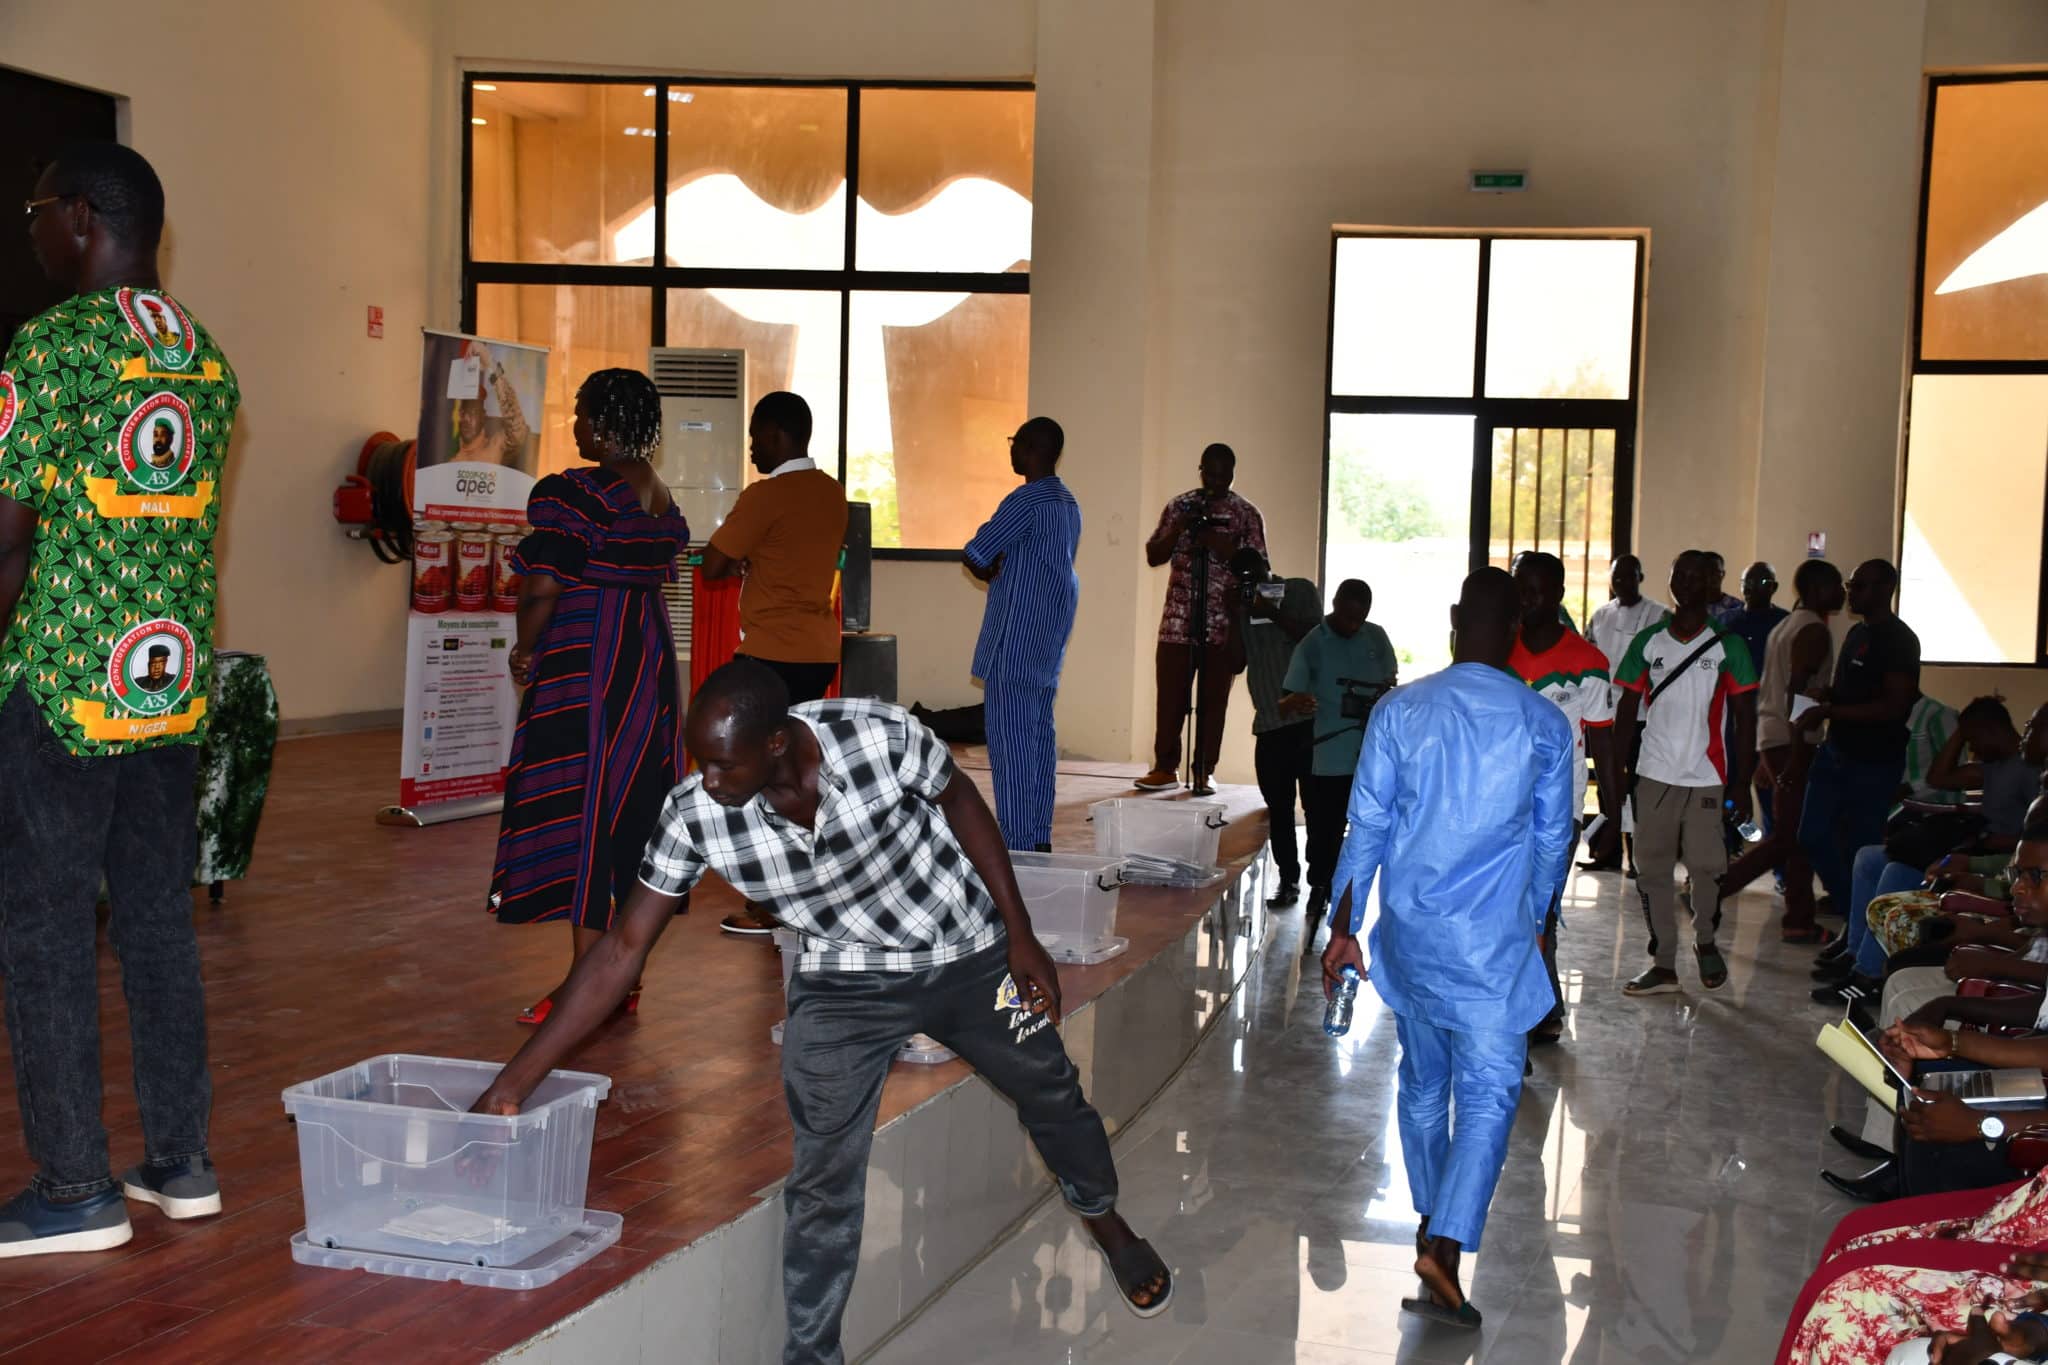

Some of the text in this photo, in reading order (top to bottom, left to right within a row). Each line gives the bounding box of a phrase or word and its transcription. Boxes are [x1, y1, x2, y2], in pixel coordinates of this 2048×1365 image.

[123, 399, 161, 461] CONFEDERATION
[456, 478, 496, 496] apec
[140, 502, 170, 514] MALI
[112, 626, 153, 687] CONFEDERATION
[129, 721, 167, 735] NIGER
